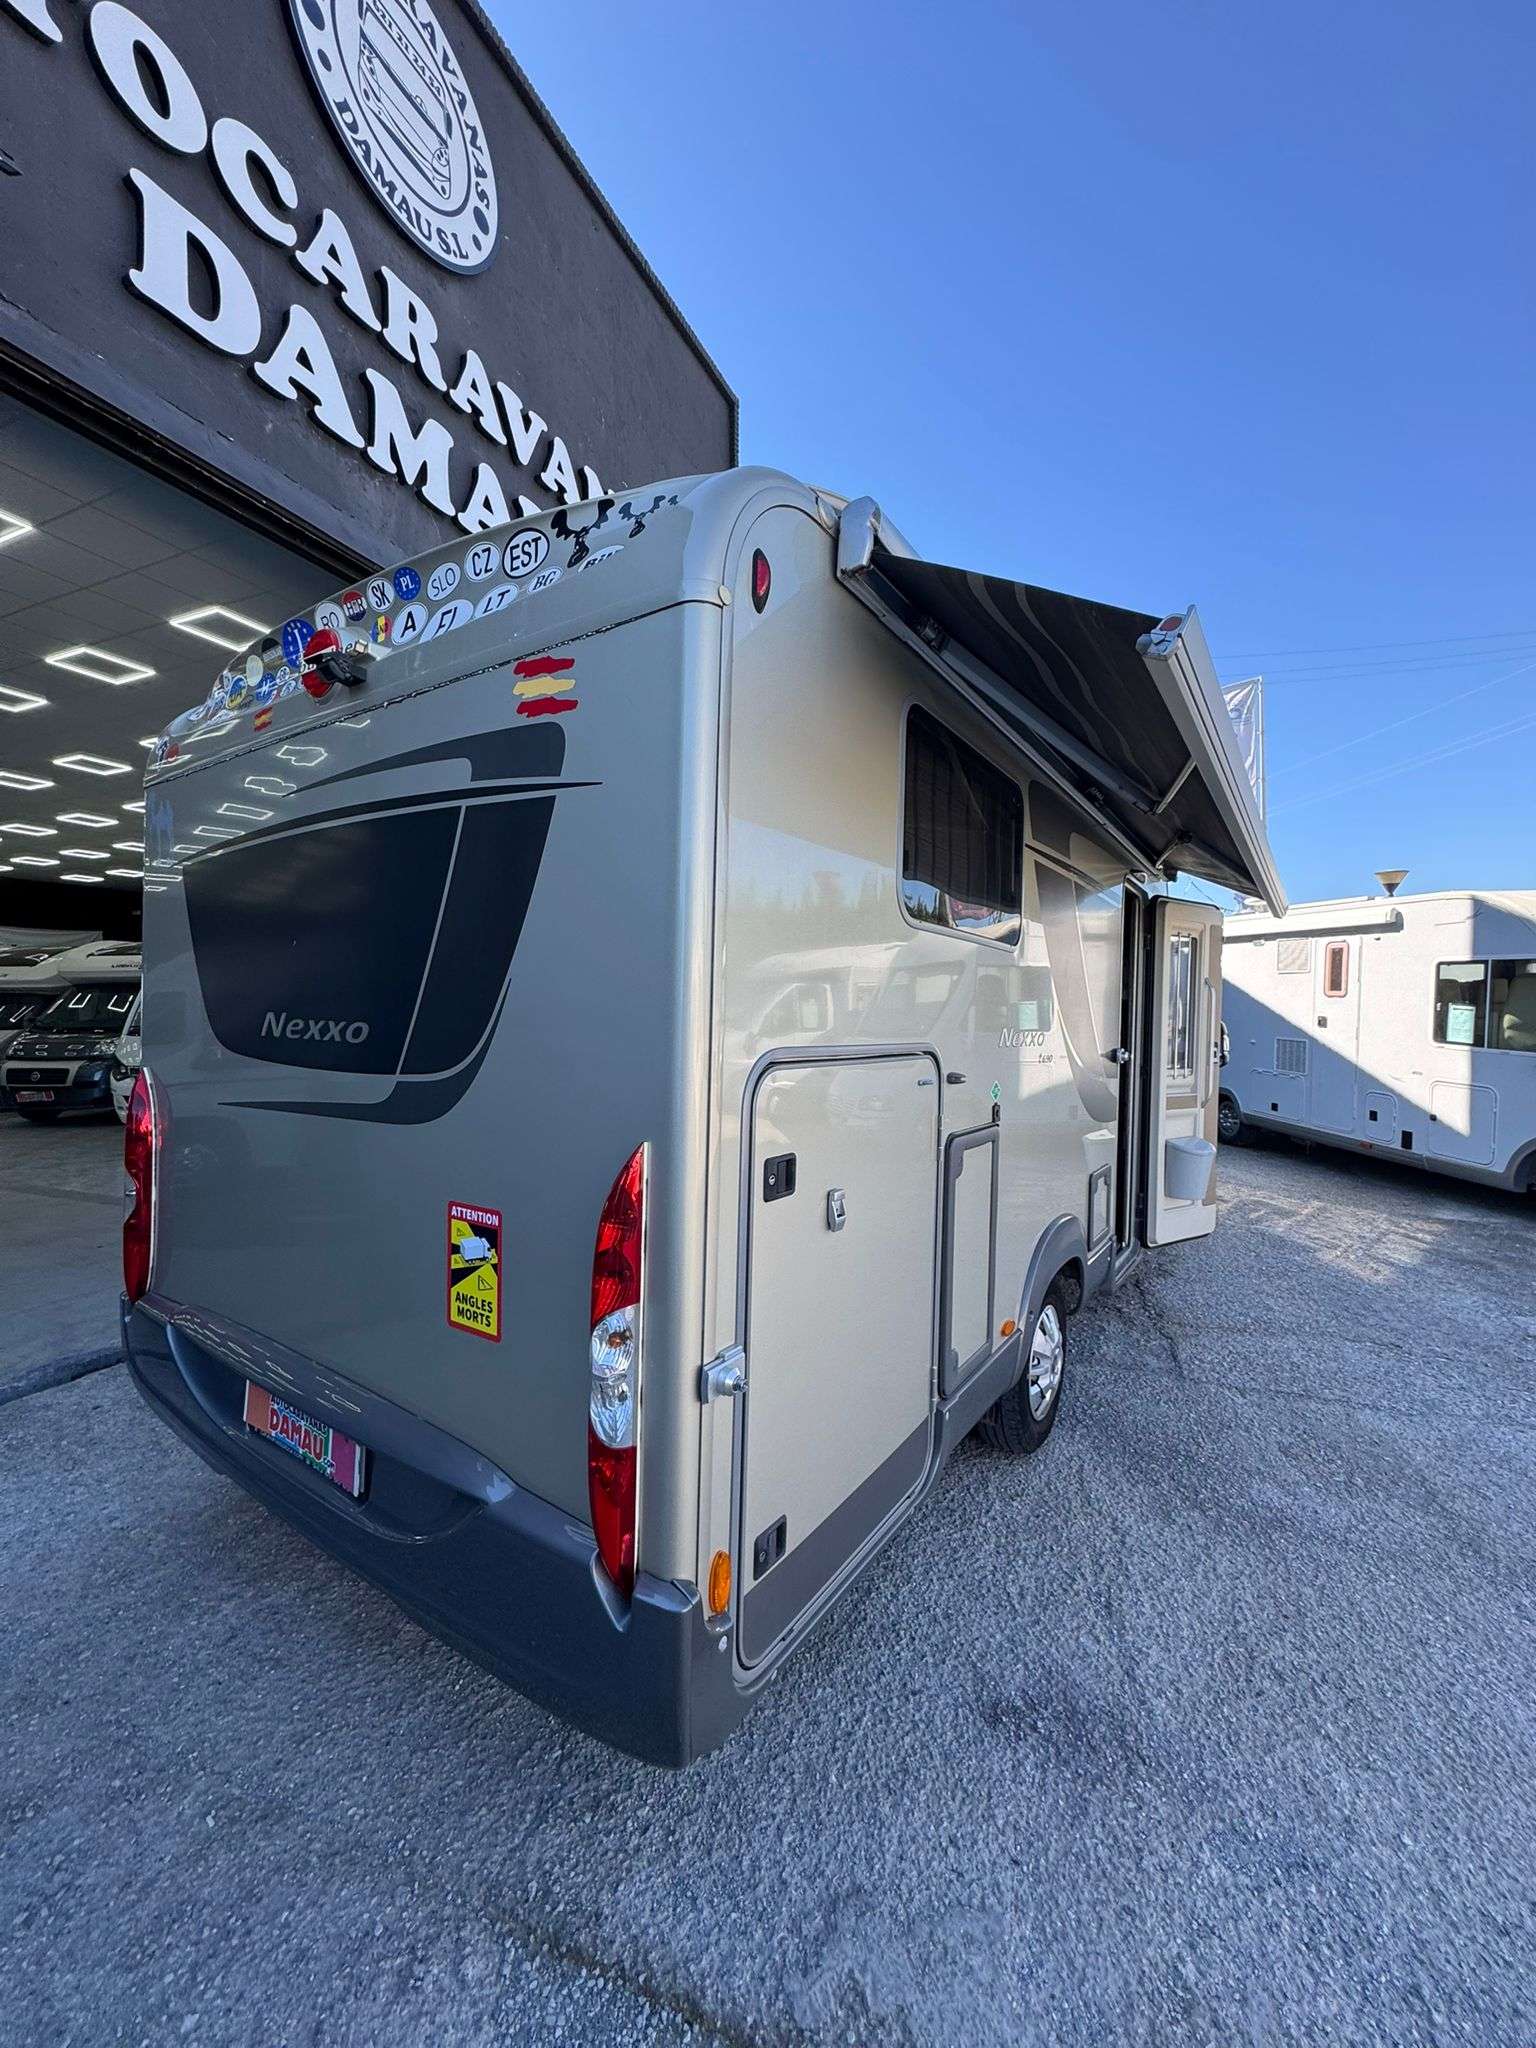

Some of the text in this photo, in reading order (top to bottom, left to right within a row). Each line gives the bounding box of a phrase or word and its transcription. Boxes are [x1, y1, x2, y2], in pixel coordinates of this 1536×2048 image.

[333, 97, 432, 242] DAMAU
[6, 0, 615, 504] OCARAVA
[129, 168, 543, 535] DAMA
[472, 547, 494, 577] CZ
[509, 536, 542, 573] EST
[400, 575, 415, 592] PL
[431, 567, 457, 598] SLO
[532, 570, 557, 591] BG
[371, 582, 391, 608] SK
[482, 589, 511, 615] LT
[400, 610, 417, 638] A
[260, 1011, 370, 1044] Nexxo
[998, 1028, 1045, 1049] Nexxo
[451, 1205, 499, 1227] ATTENTION
[454, 1290, 494, 1315] ANGLES
[456, 1304, 492, 1328] MORTS
[269, 1407, 325, 1462] DAMAU
